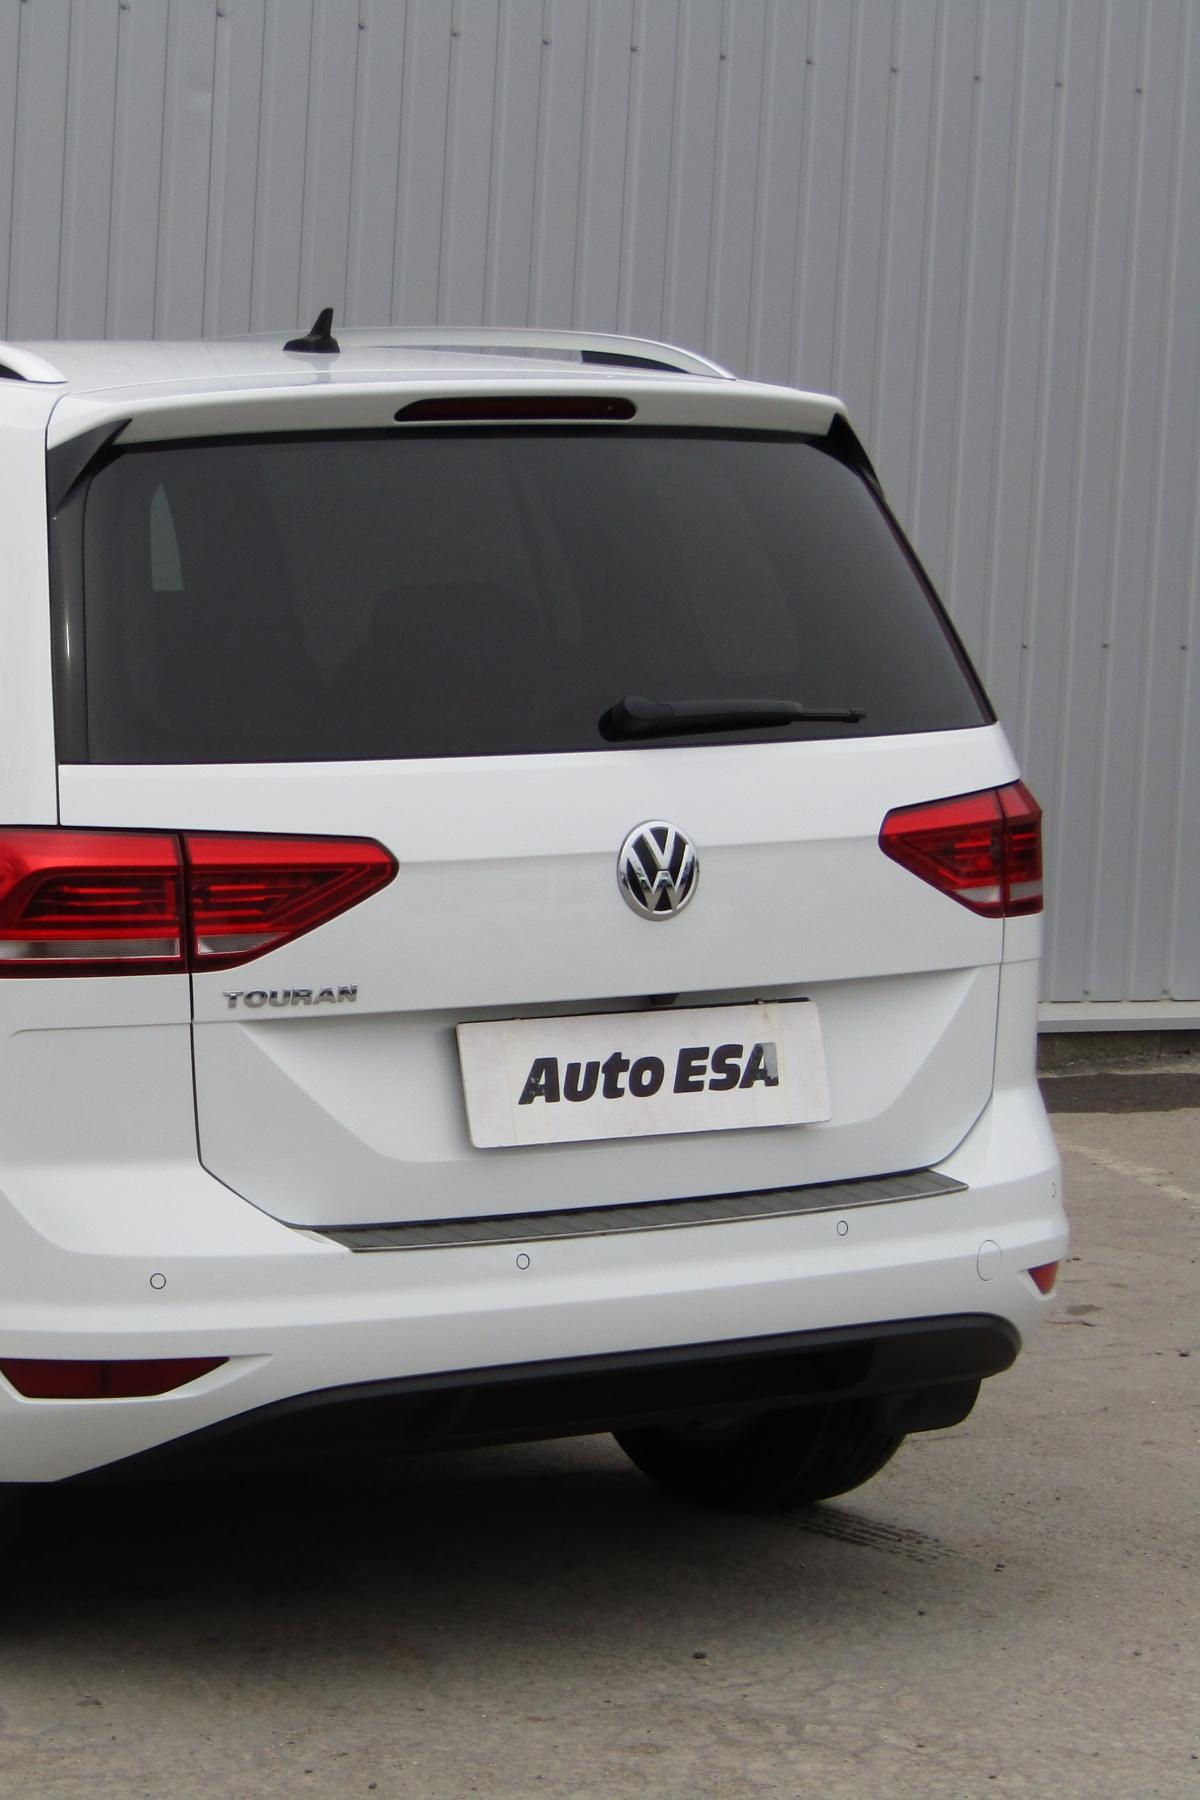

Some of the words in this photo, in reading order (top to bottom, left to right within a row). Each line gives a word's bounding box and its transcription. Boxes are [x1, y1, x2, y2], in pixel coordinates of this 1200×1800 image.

[222, 984, 358, 1009] TOURAN
[518, 1051, 665, 1105] Auto
[673, 1042, 779, 1094] ESA
